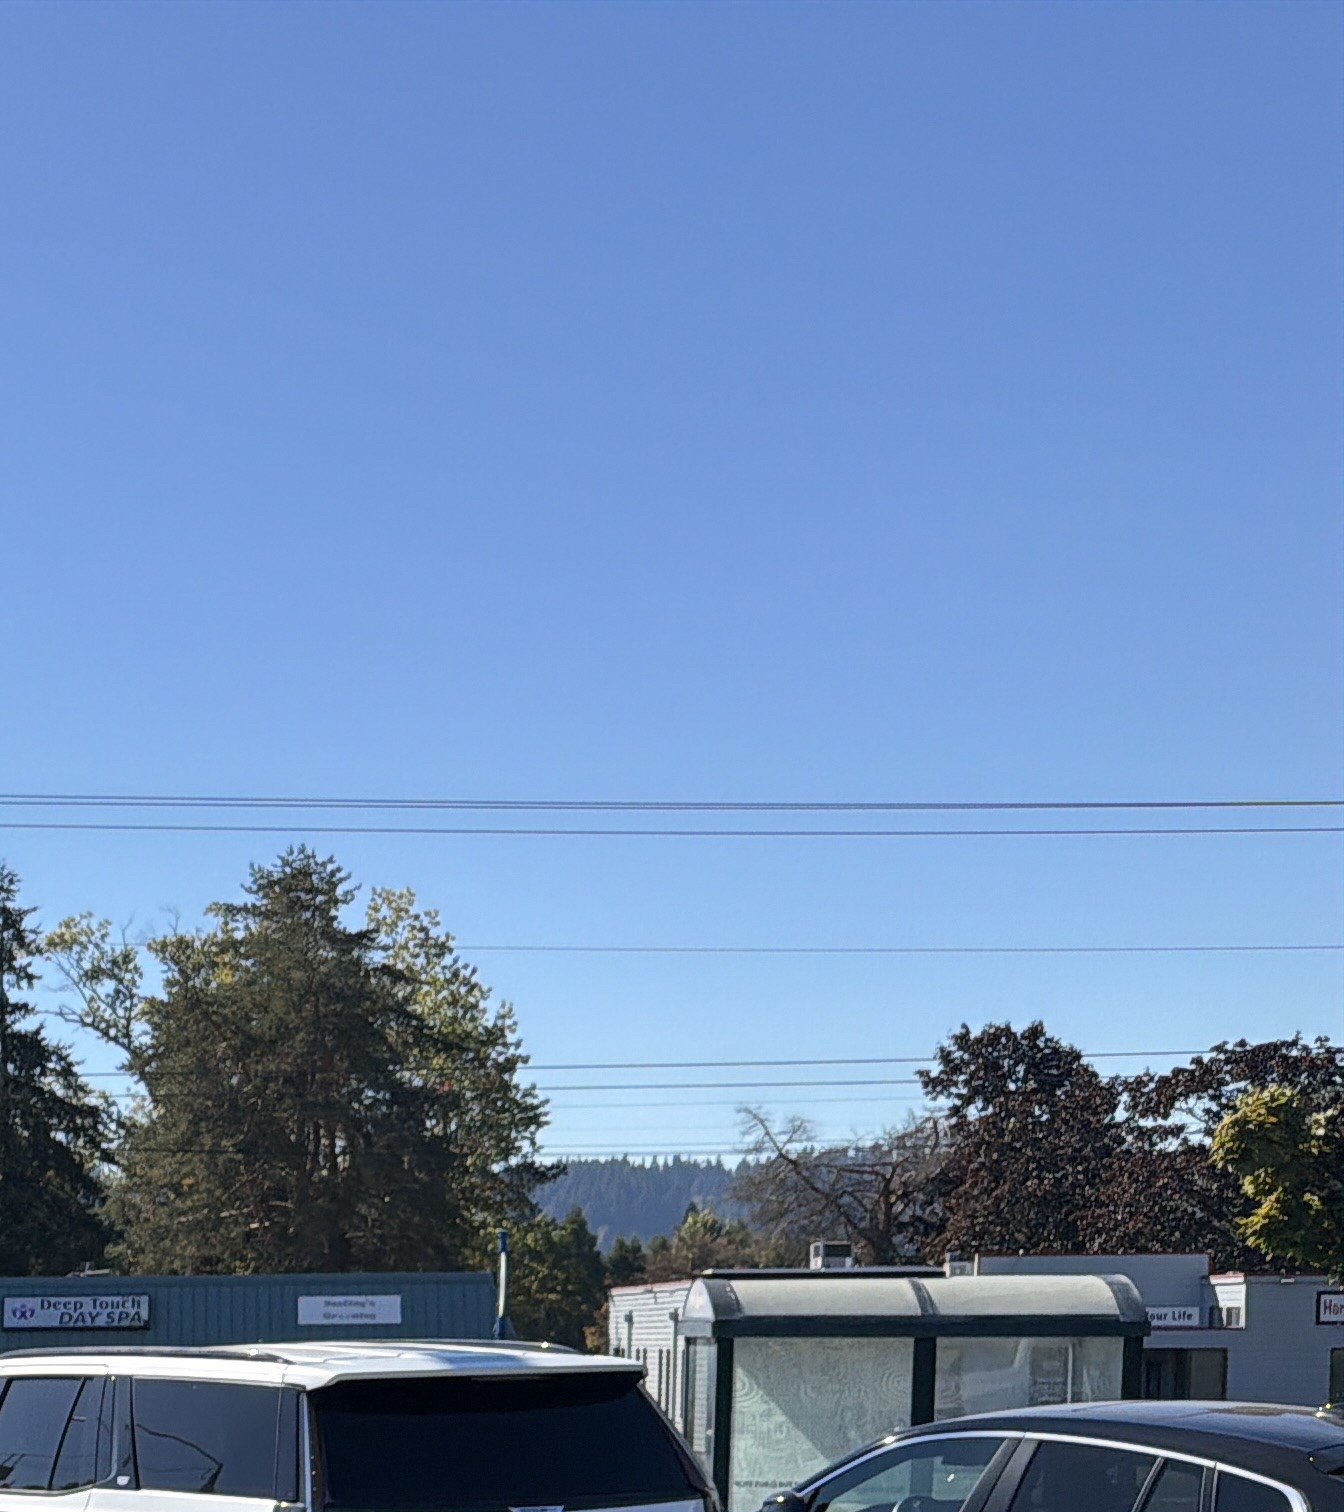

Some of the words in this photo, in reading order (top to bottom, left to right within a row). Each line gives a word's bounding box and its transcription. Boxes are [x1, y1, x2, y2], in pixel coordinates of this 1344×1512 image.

[40, 1298, 84, 1313] Deep
[92, 1298, 141, 1311] Touch
[59, 1311, 102, 1325] DAY
[106, 1311, 142, 1325] SPA
[1148, 1312, 1167, 1321] our
[1173, 1310, 1193, 1321] Life
